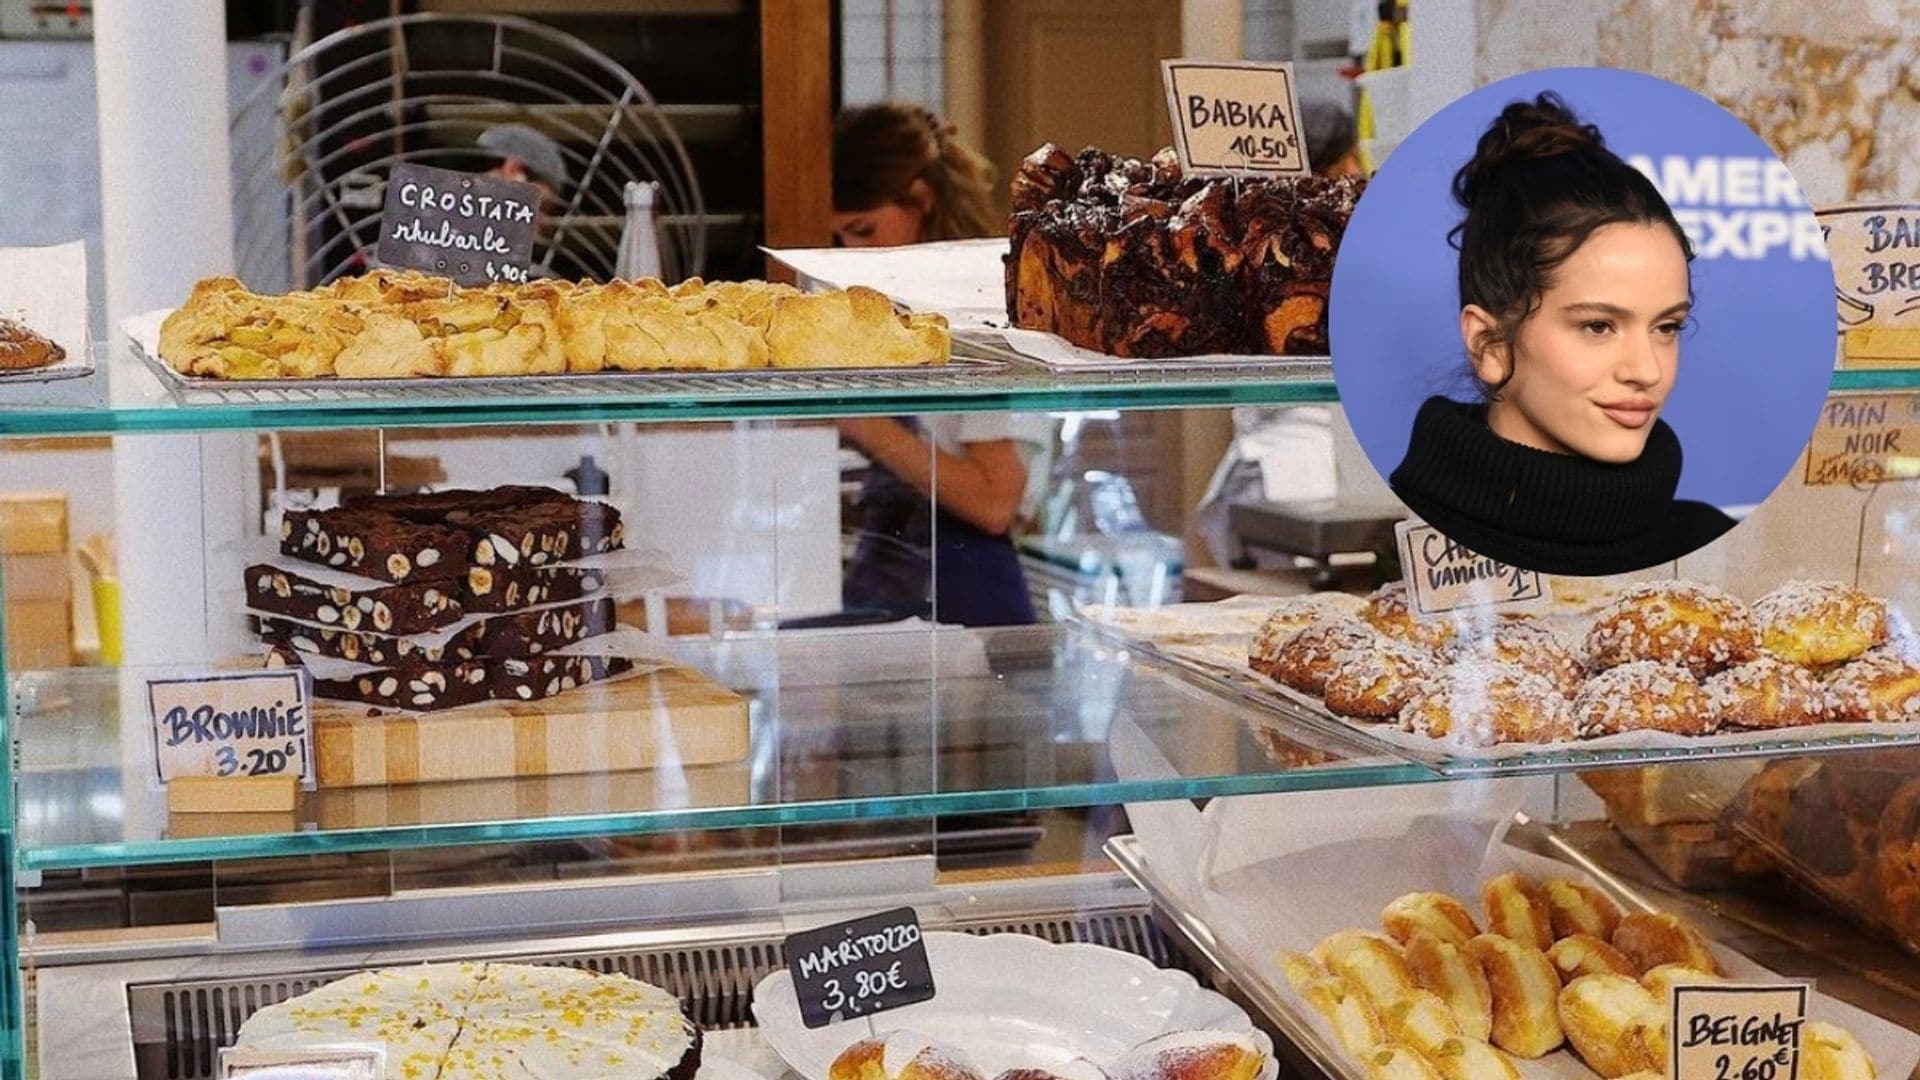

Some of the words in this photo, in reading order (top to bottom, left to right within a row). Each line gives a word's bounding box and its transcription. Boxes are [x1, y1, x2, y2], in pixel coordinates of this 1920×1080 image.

[1188, 95, 1288, 132] BABKA
[401, 183, 533, 223] CROSTATA
[392, 218, 510, 253] rhubarbe
[1845, 429, 1901, 454] NOIR
[822, 961, 907, 1010] 3,80€
